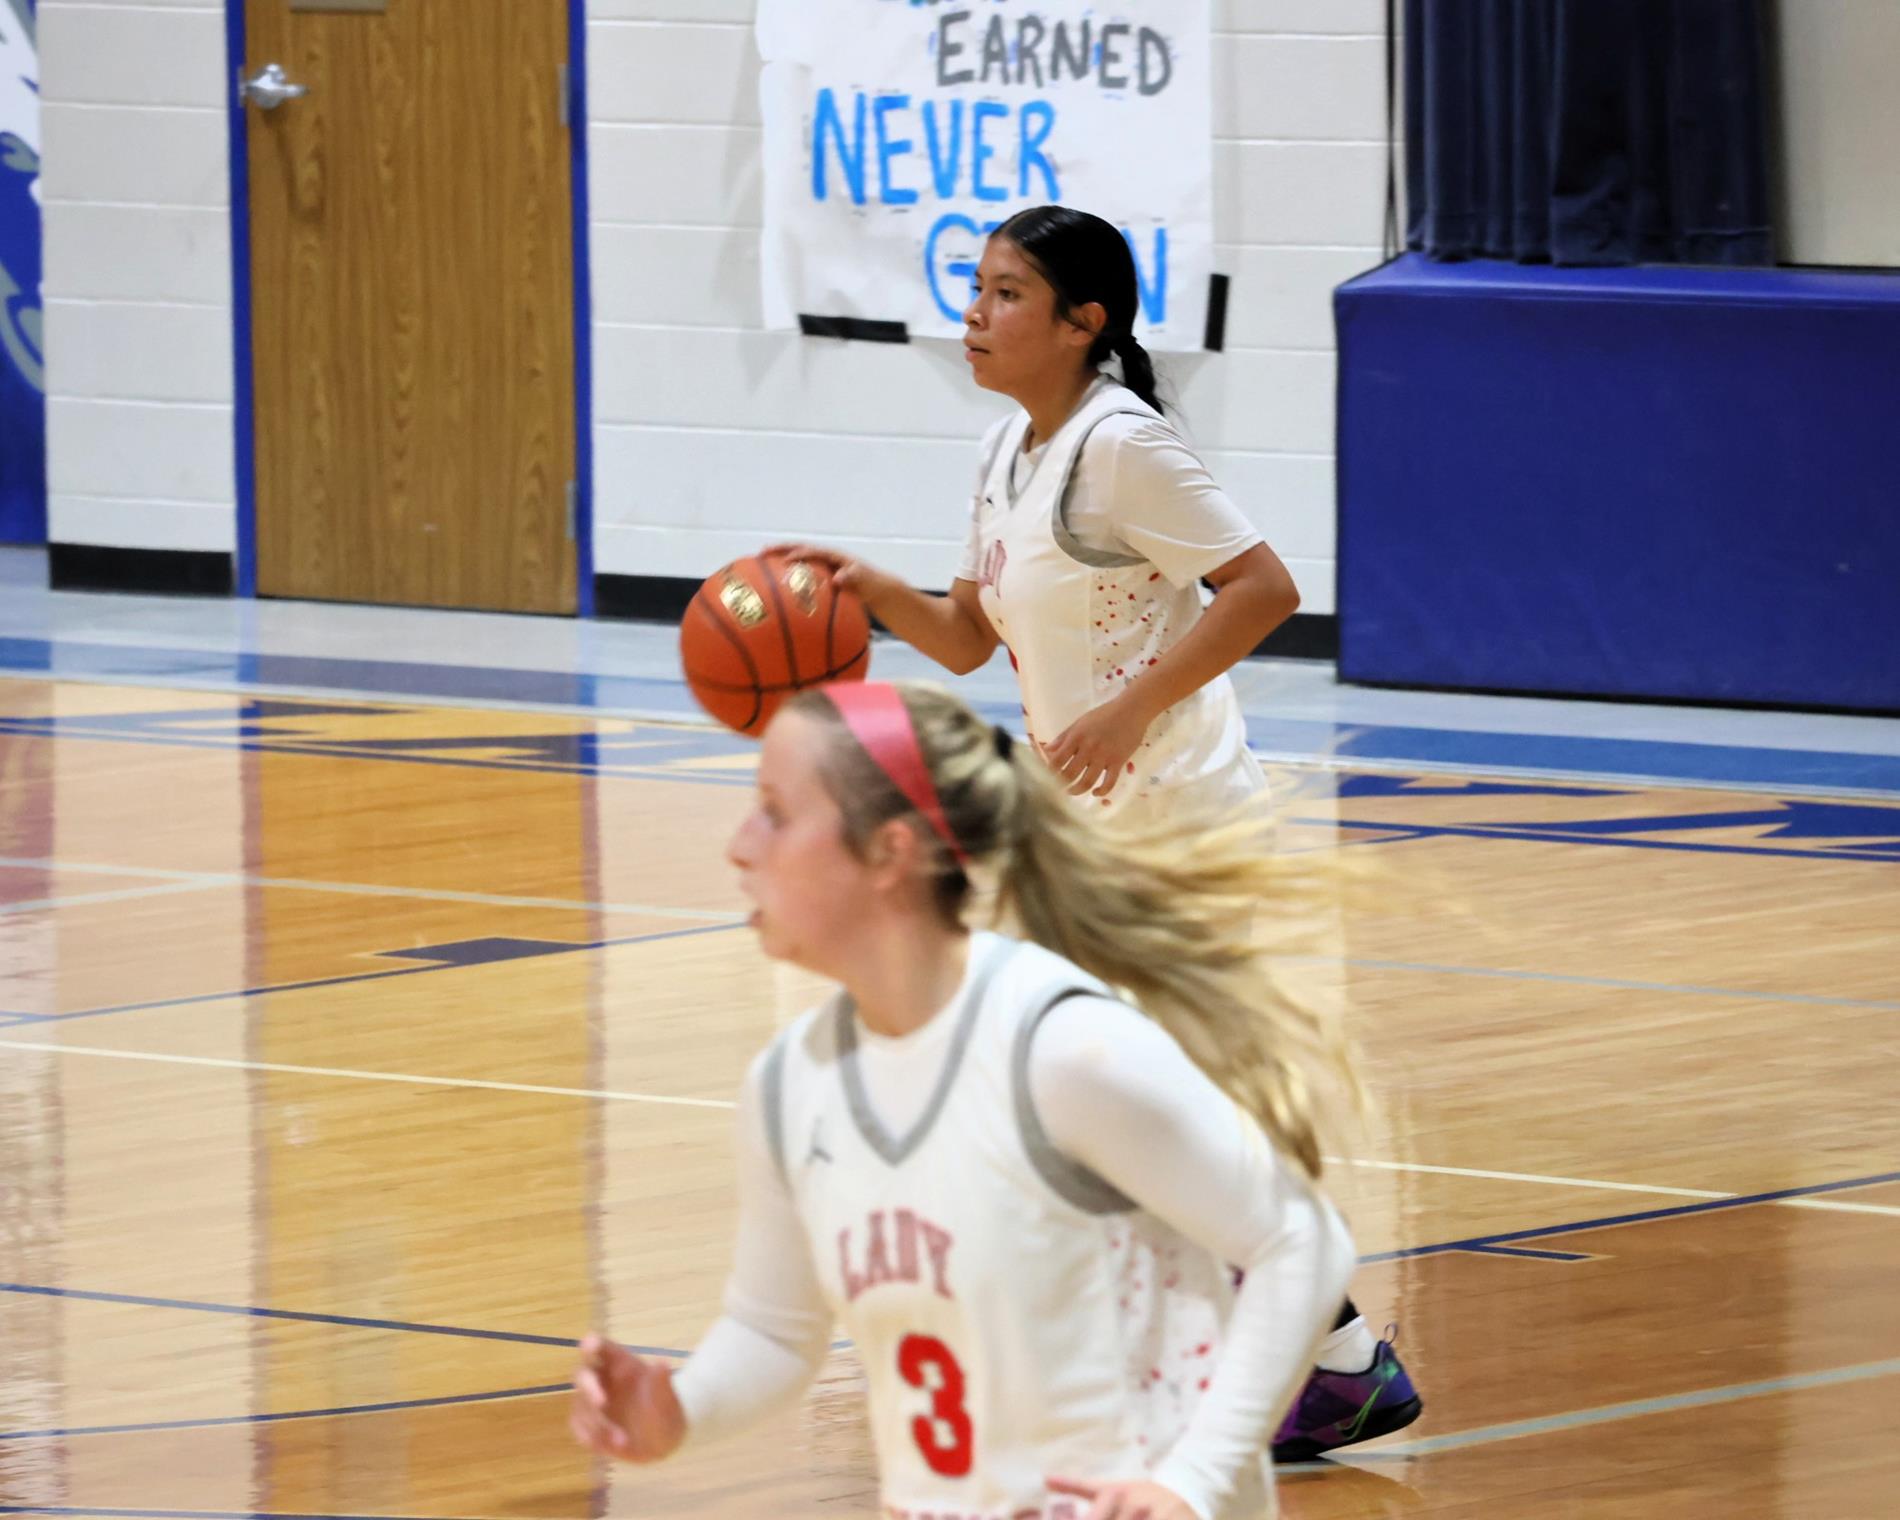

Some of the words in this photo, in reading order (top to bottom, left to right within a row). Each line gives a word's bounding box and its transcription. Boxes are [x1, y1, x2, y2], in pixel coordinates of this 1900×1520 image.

[936, 11, 1173, 96] EARNED
[812, 88, 1061, 205] NEVER
[837, 1207, 956, 1301] LADY
[896, 1332, 974, 1479] 3
